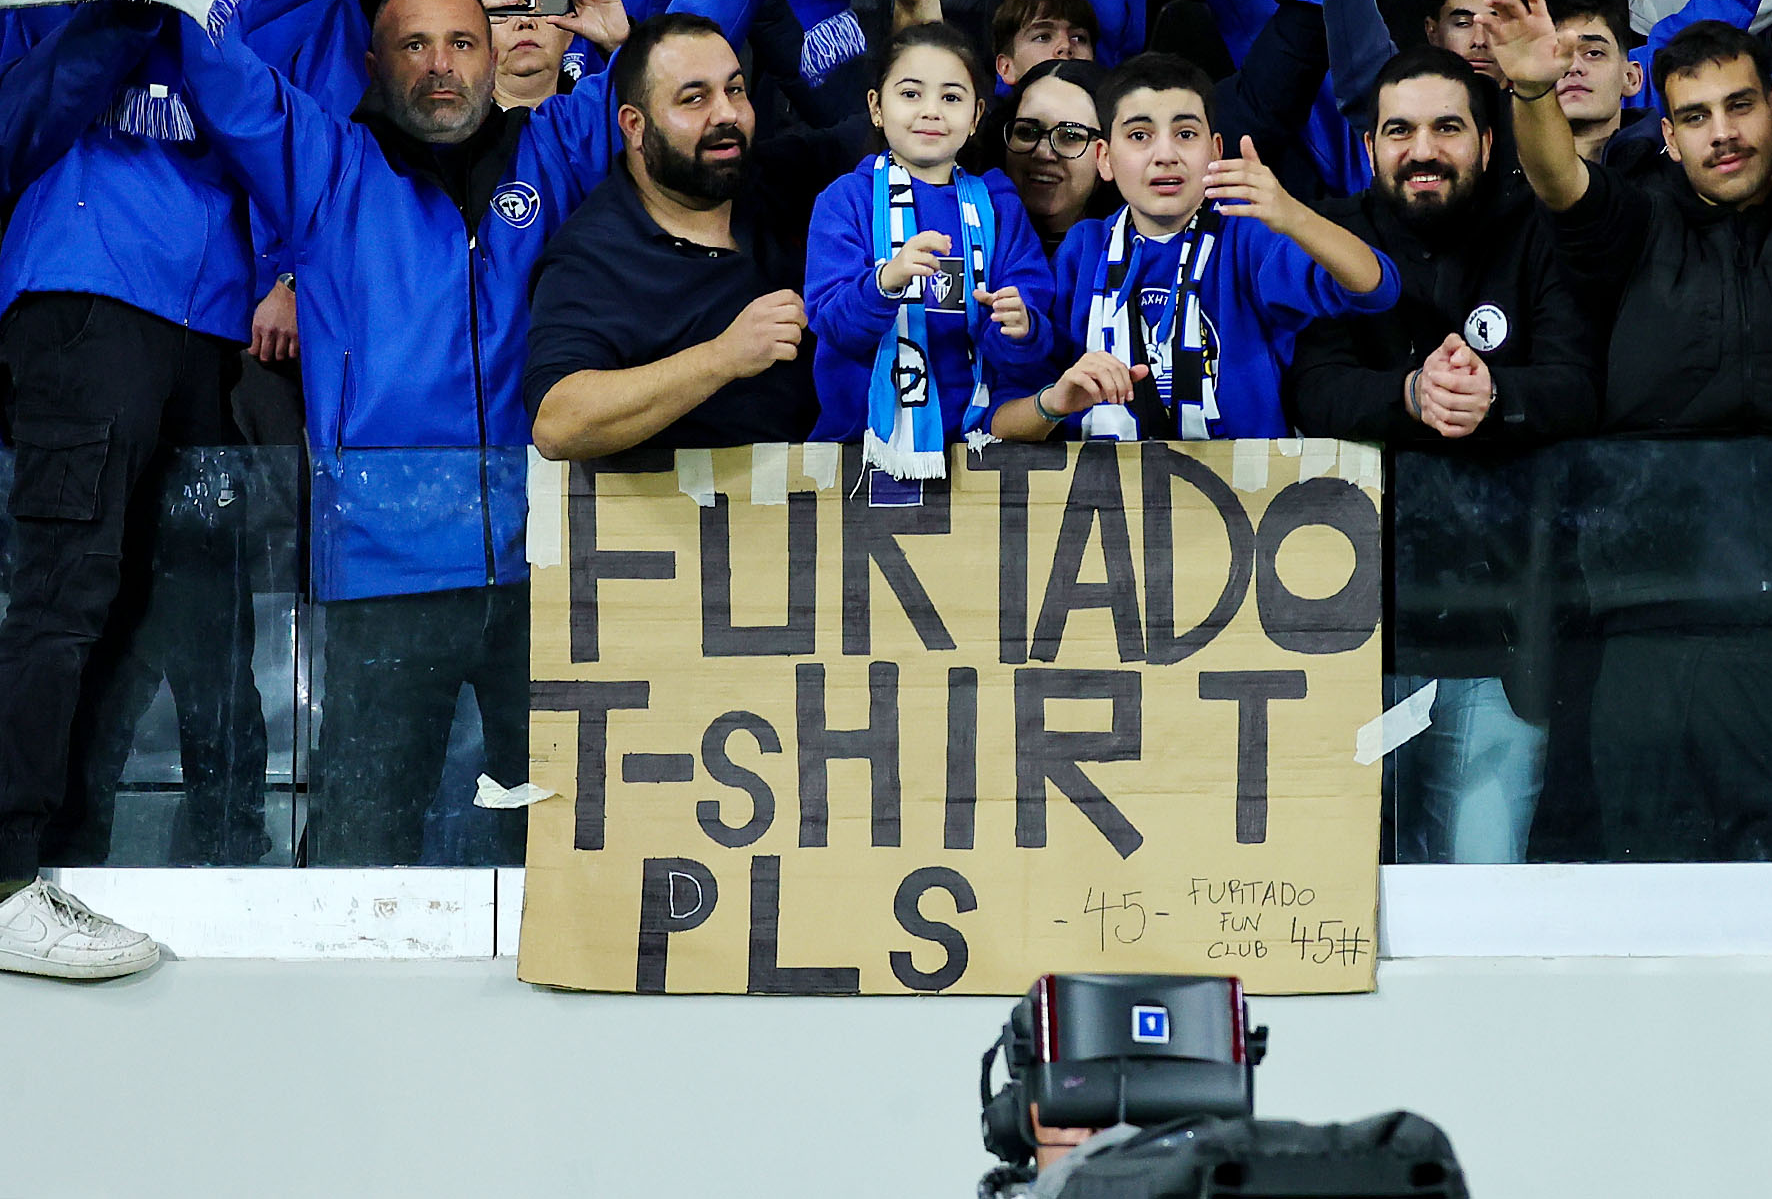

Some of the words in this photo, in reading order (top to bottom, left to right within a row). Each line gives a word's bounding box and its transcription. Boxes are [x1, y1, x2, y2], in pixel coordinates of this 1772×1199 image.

[567, 439, 1383, 665] FURTADO
[1188, 877, 1316, 907] FURTADO
[636, 854, 978, 994] PLS
[1219, 911, 1262, 933] FUN
[1207, 941, 1269, 959] CLUB
